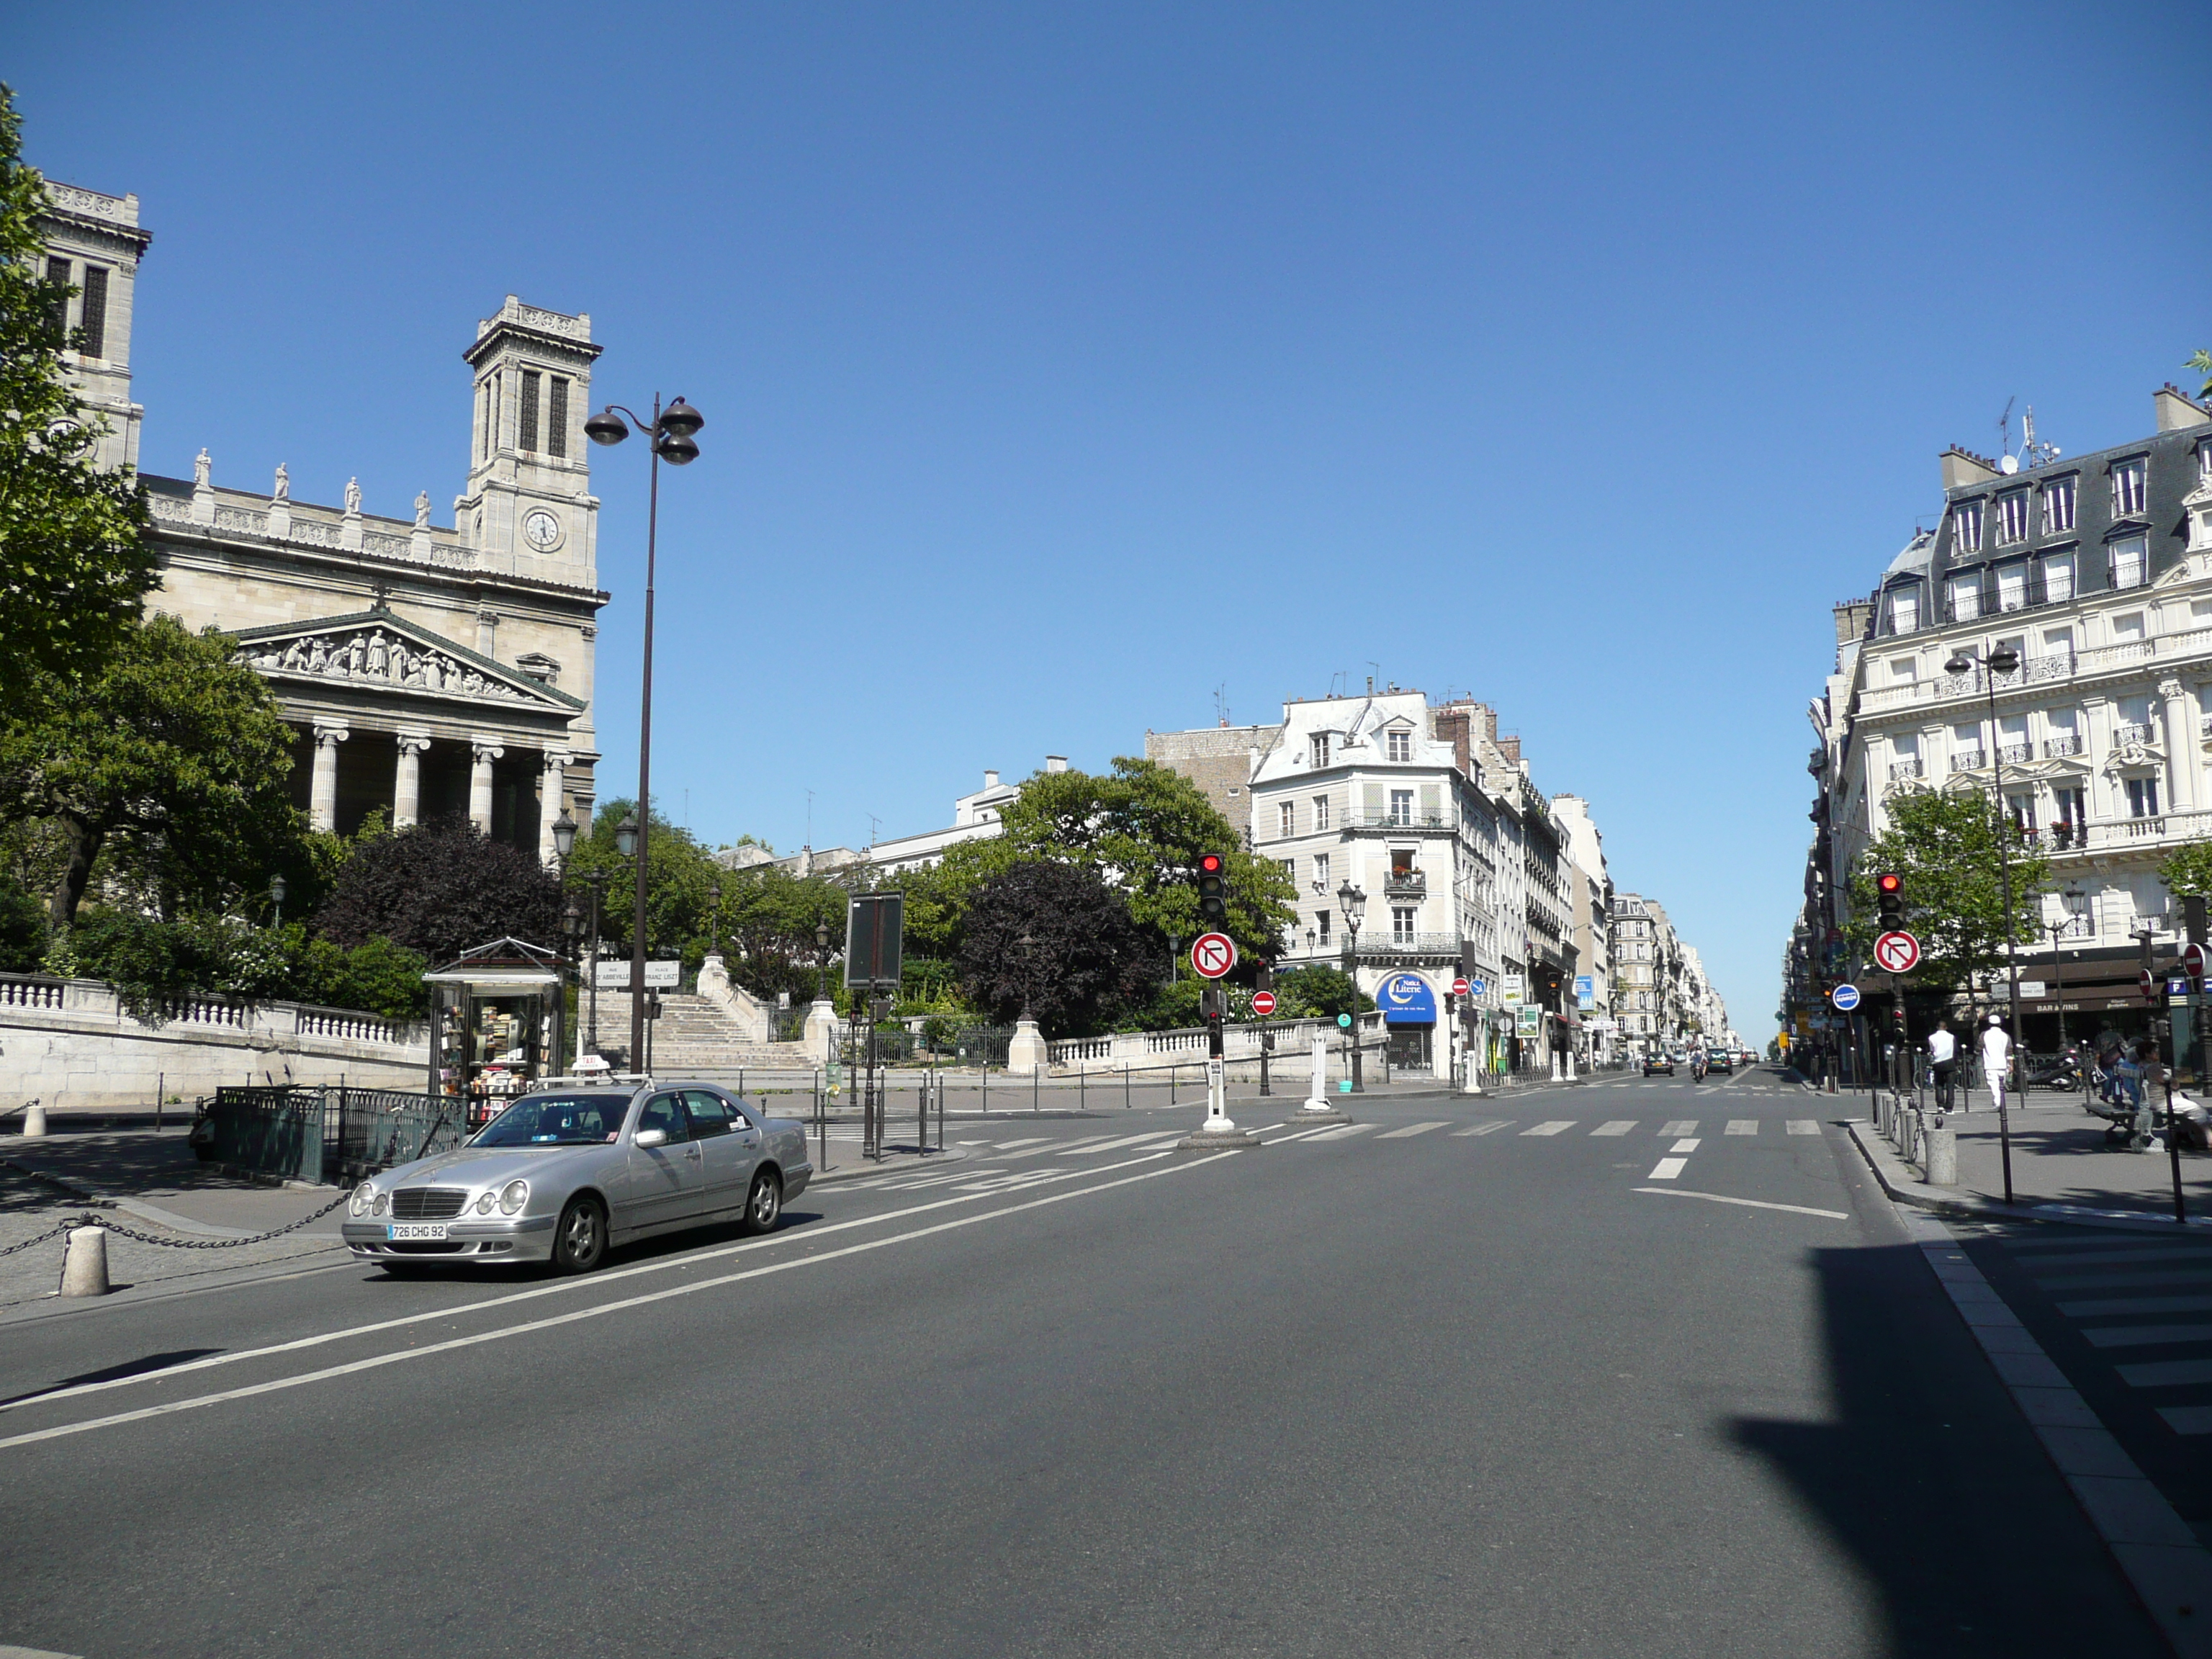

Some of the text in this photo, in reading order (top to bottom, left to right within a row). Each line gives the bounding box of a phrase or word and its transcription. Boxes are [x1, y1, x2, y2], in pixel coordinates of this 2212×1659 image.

[1395, 984, 1421, 993] Literie
[2172, 984, 2180, 992] P
[393, 1226, 444, 1237] 726 CHG 92
